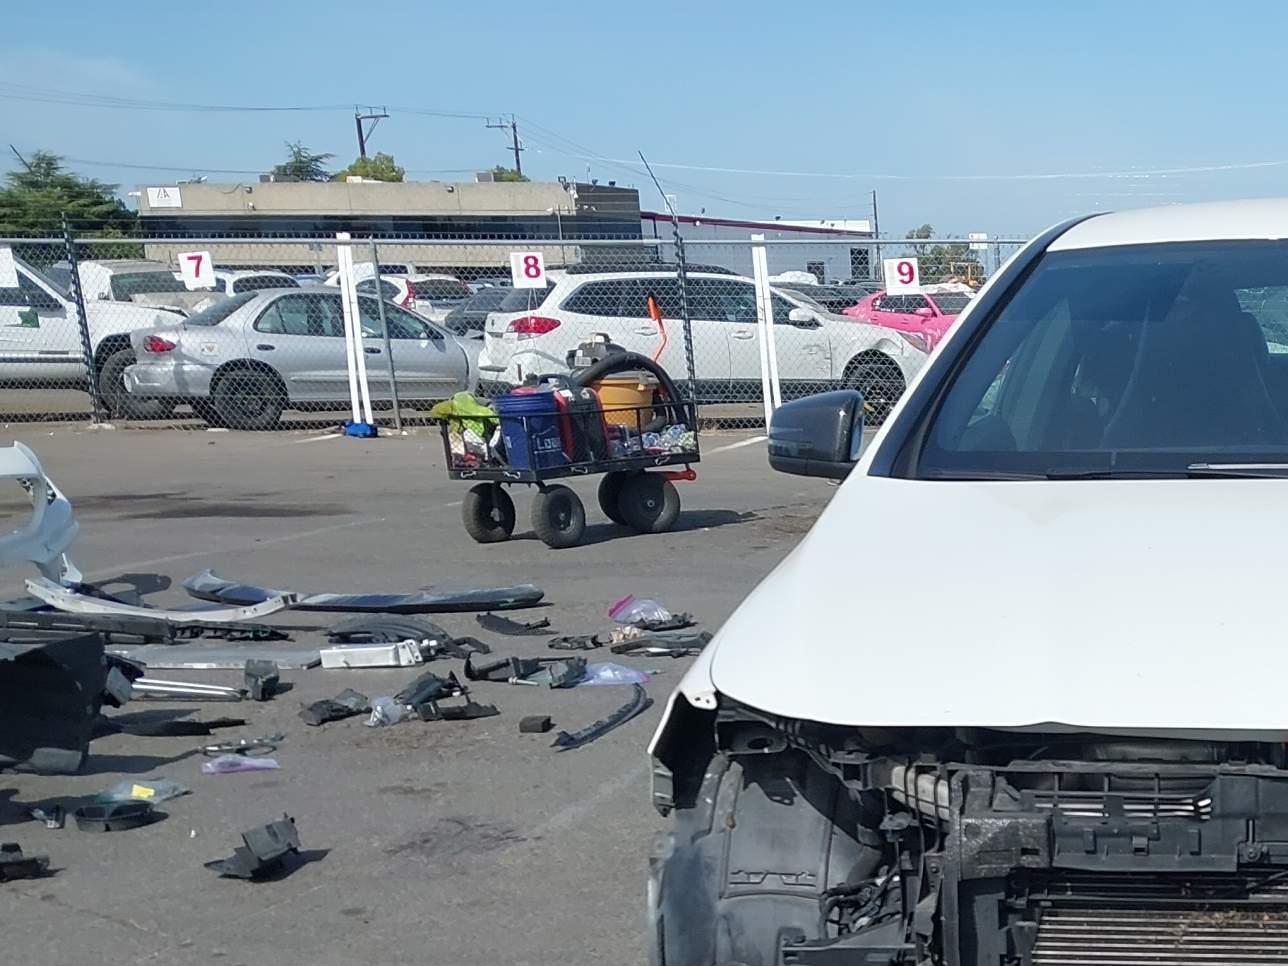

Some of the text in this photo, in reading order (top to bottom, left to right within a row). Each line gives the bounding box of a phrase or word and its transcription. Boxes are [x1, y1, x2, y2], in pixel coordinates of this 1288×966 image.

[186, 255, 203, 278] 7
[523, 255, 541, 278] 8
[896, 261, 915, 285] 9
